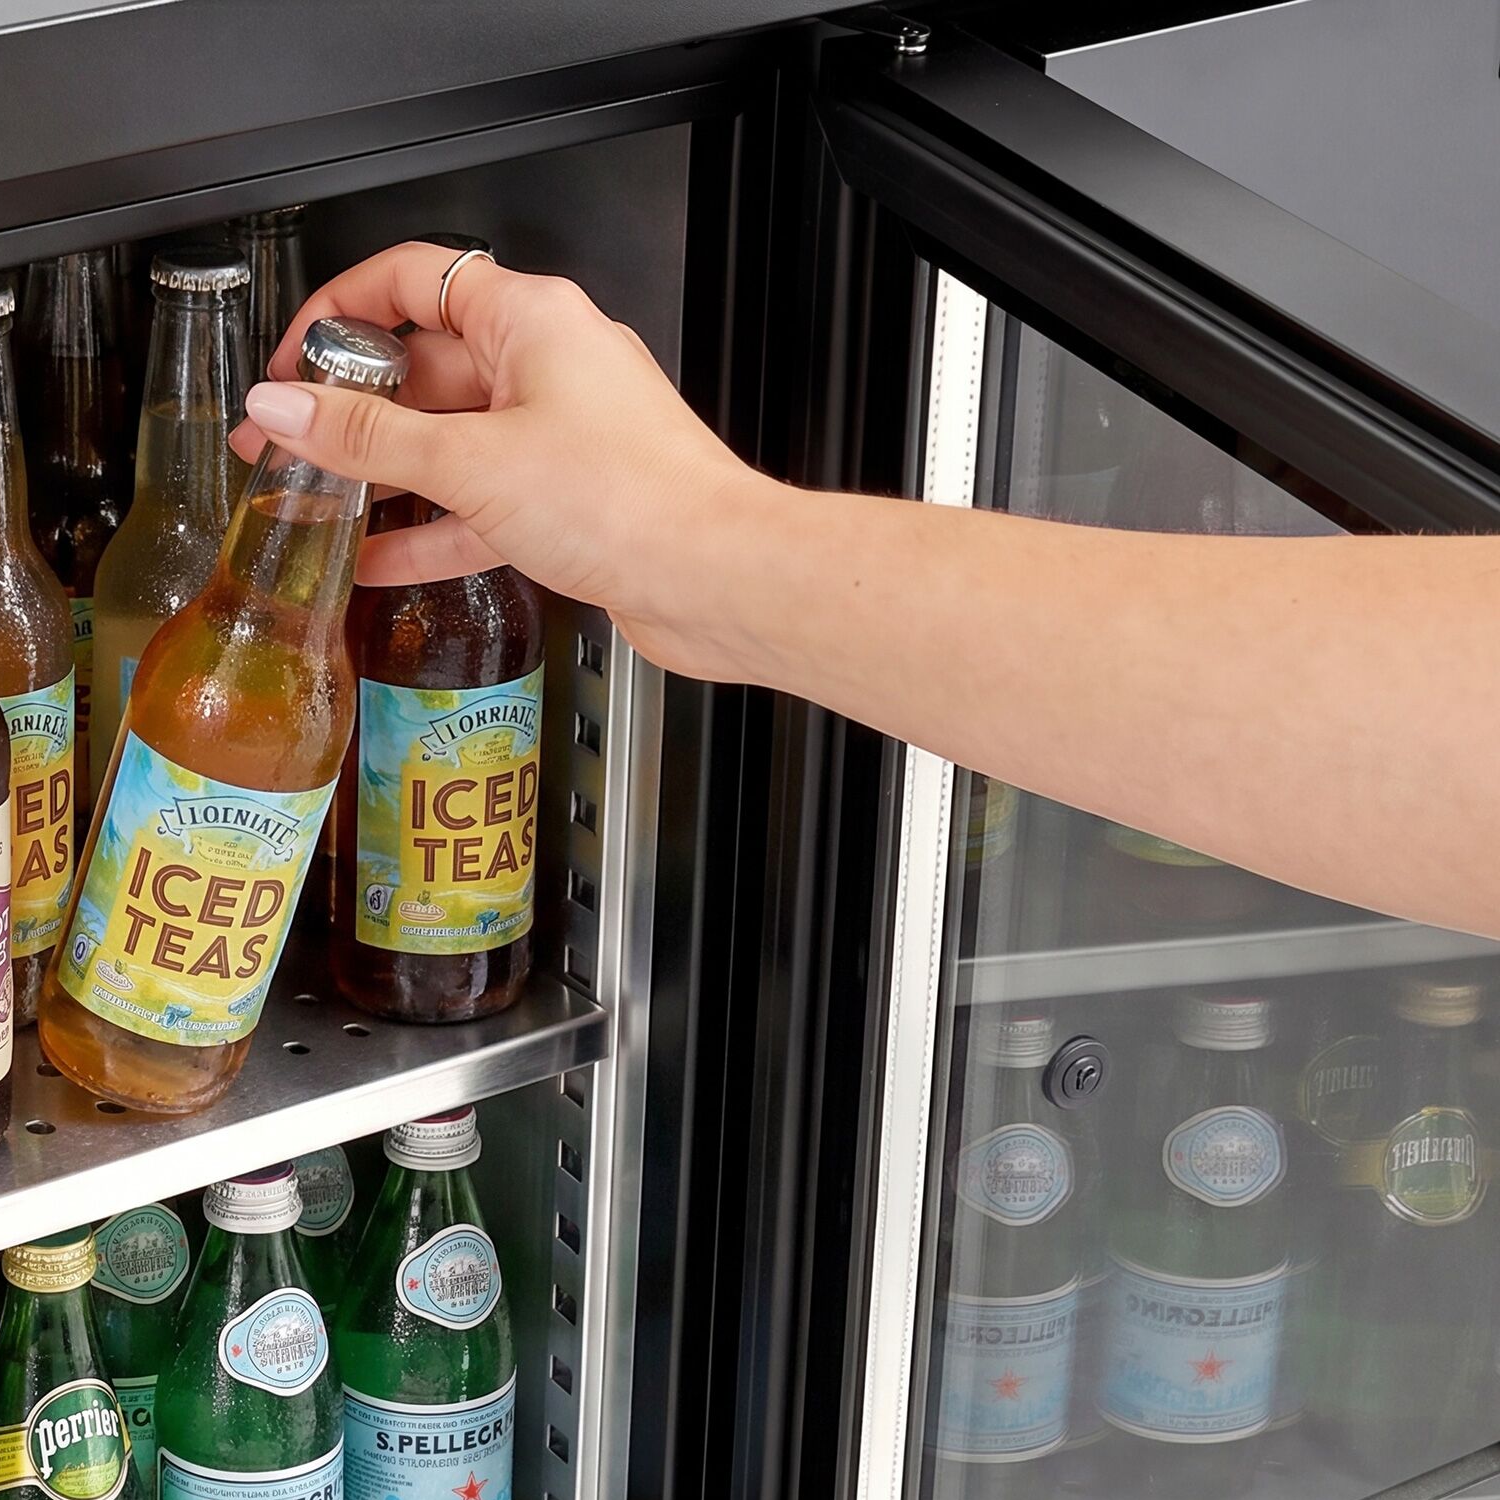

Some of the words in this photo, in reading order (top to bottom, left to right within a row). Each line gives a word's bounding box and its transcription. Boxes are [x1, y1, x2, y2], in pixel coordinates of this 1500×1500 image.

[16, 768, 71, 835] ED
[412, 761, 538, 830] ICED
[11, 824, 68, 889] AS
[413, 817, 534, 882] TEAS
[128, 846, 285, 929] ICED
[122, 904, 269, 979] TEAS
